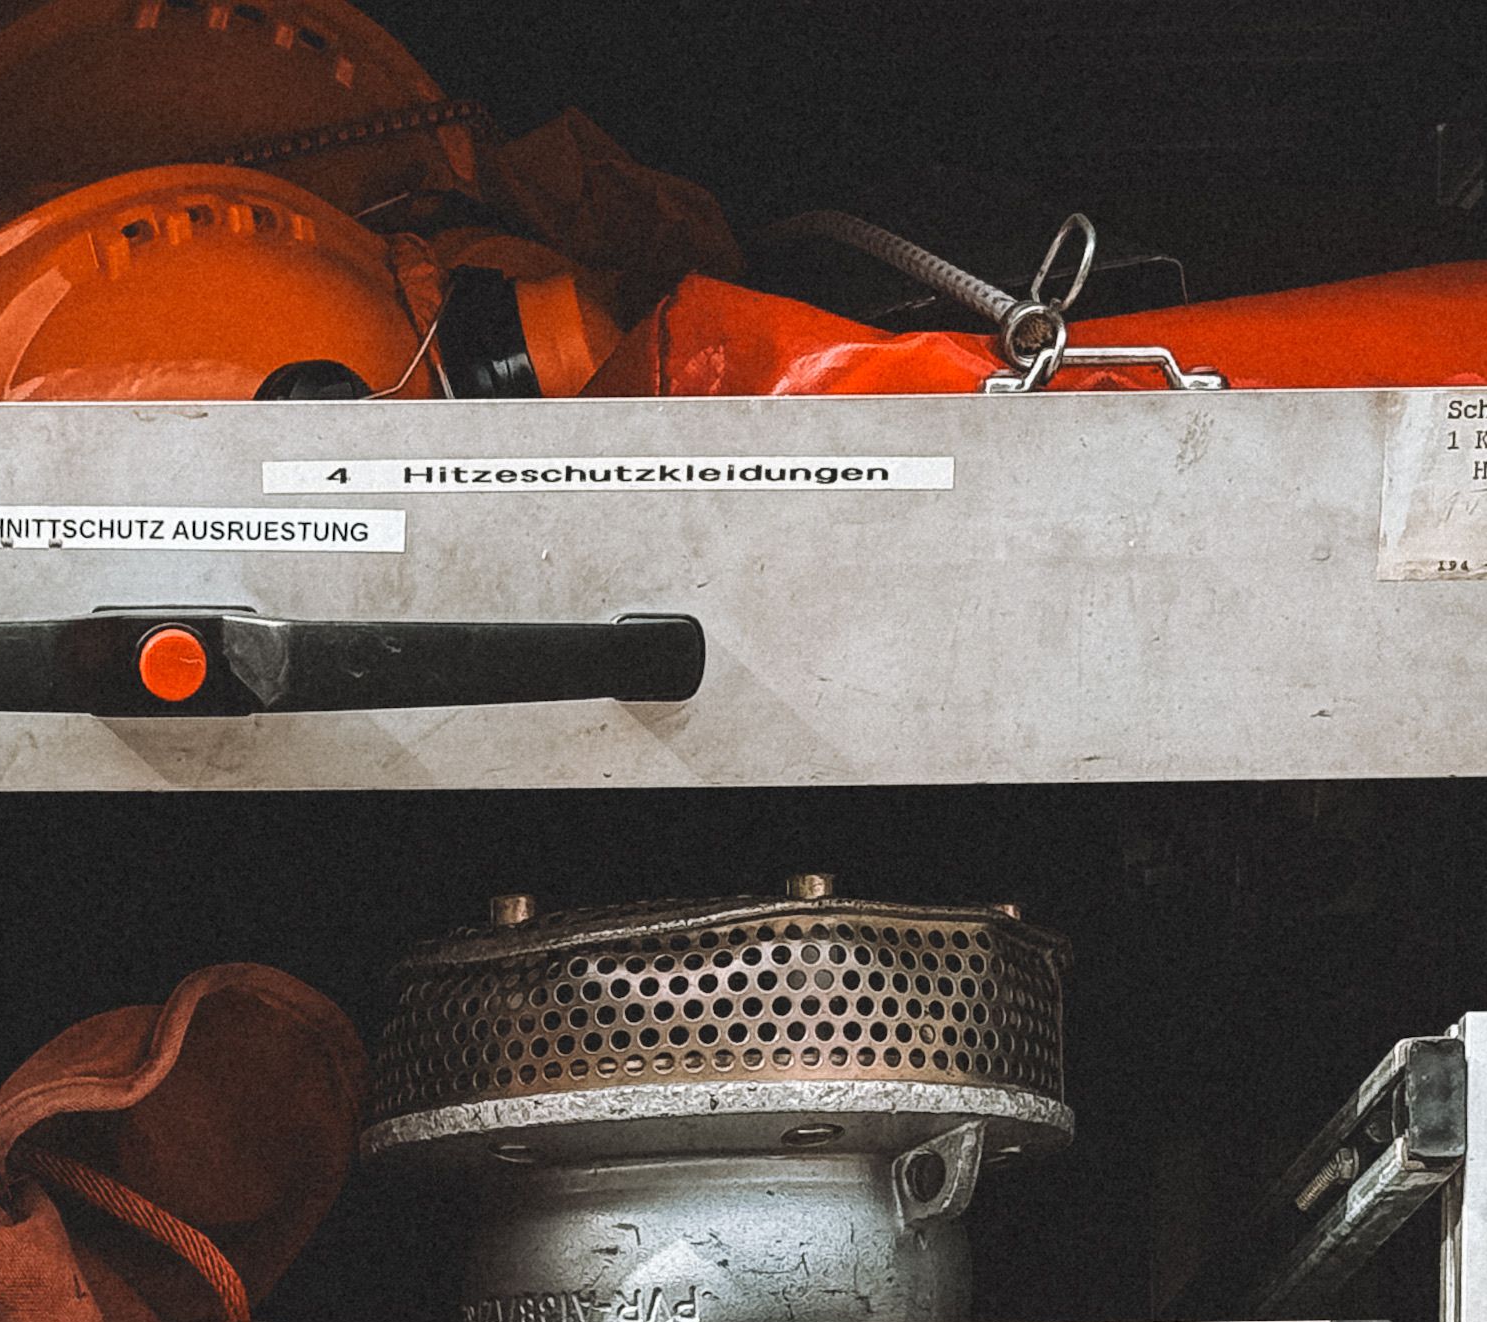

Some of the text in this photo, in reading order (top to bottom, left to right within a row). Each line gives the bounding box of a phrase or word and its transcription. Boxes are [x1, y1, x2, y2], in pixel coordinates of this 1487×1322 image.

[1447, 431, 1460, 450] 1
[325, 462, 892, 485] 4 Hitzeschutzkleidungen
[172, 519, 370, 542] AUSRUESTUNG
